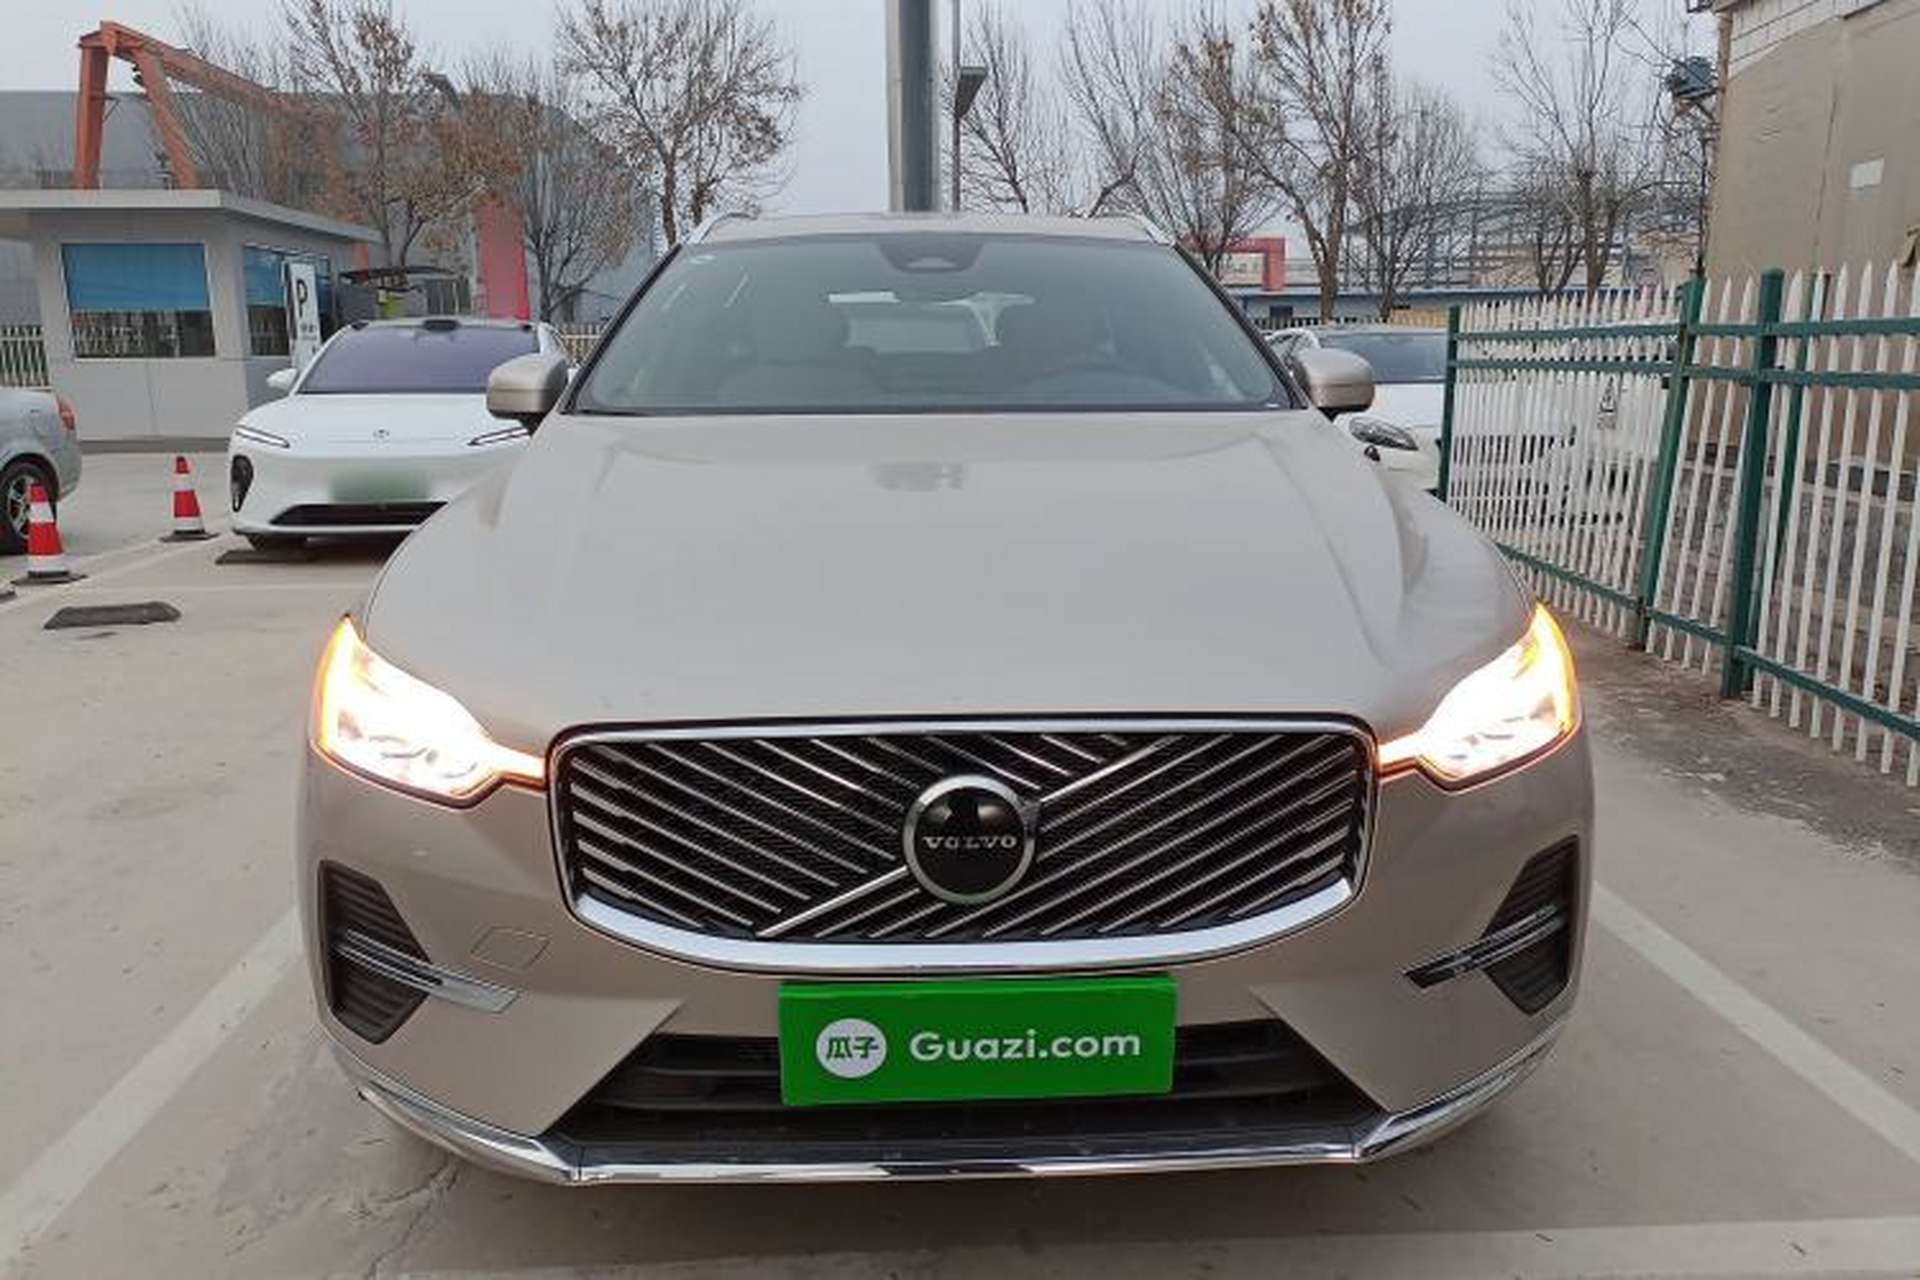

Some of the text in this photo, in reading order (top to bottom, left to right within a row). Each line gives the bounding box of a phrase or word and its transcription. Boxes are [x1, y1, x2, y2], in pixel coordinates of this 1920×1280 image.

[296, 278, 308, 318] P
[921, 835, 1018, 849] VOLVO
[826, 1028, 1141, 1061] 瓜子 Guazi.com
